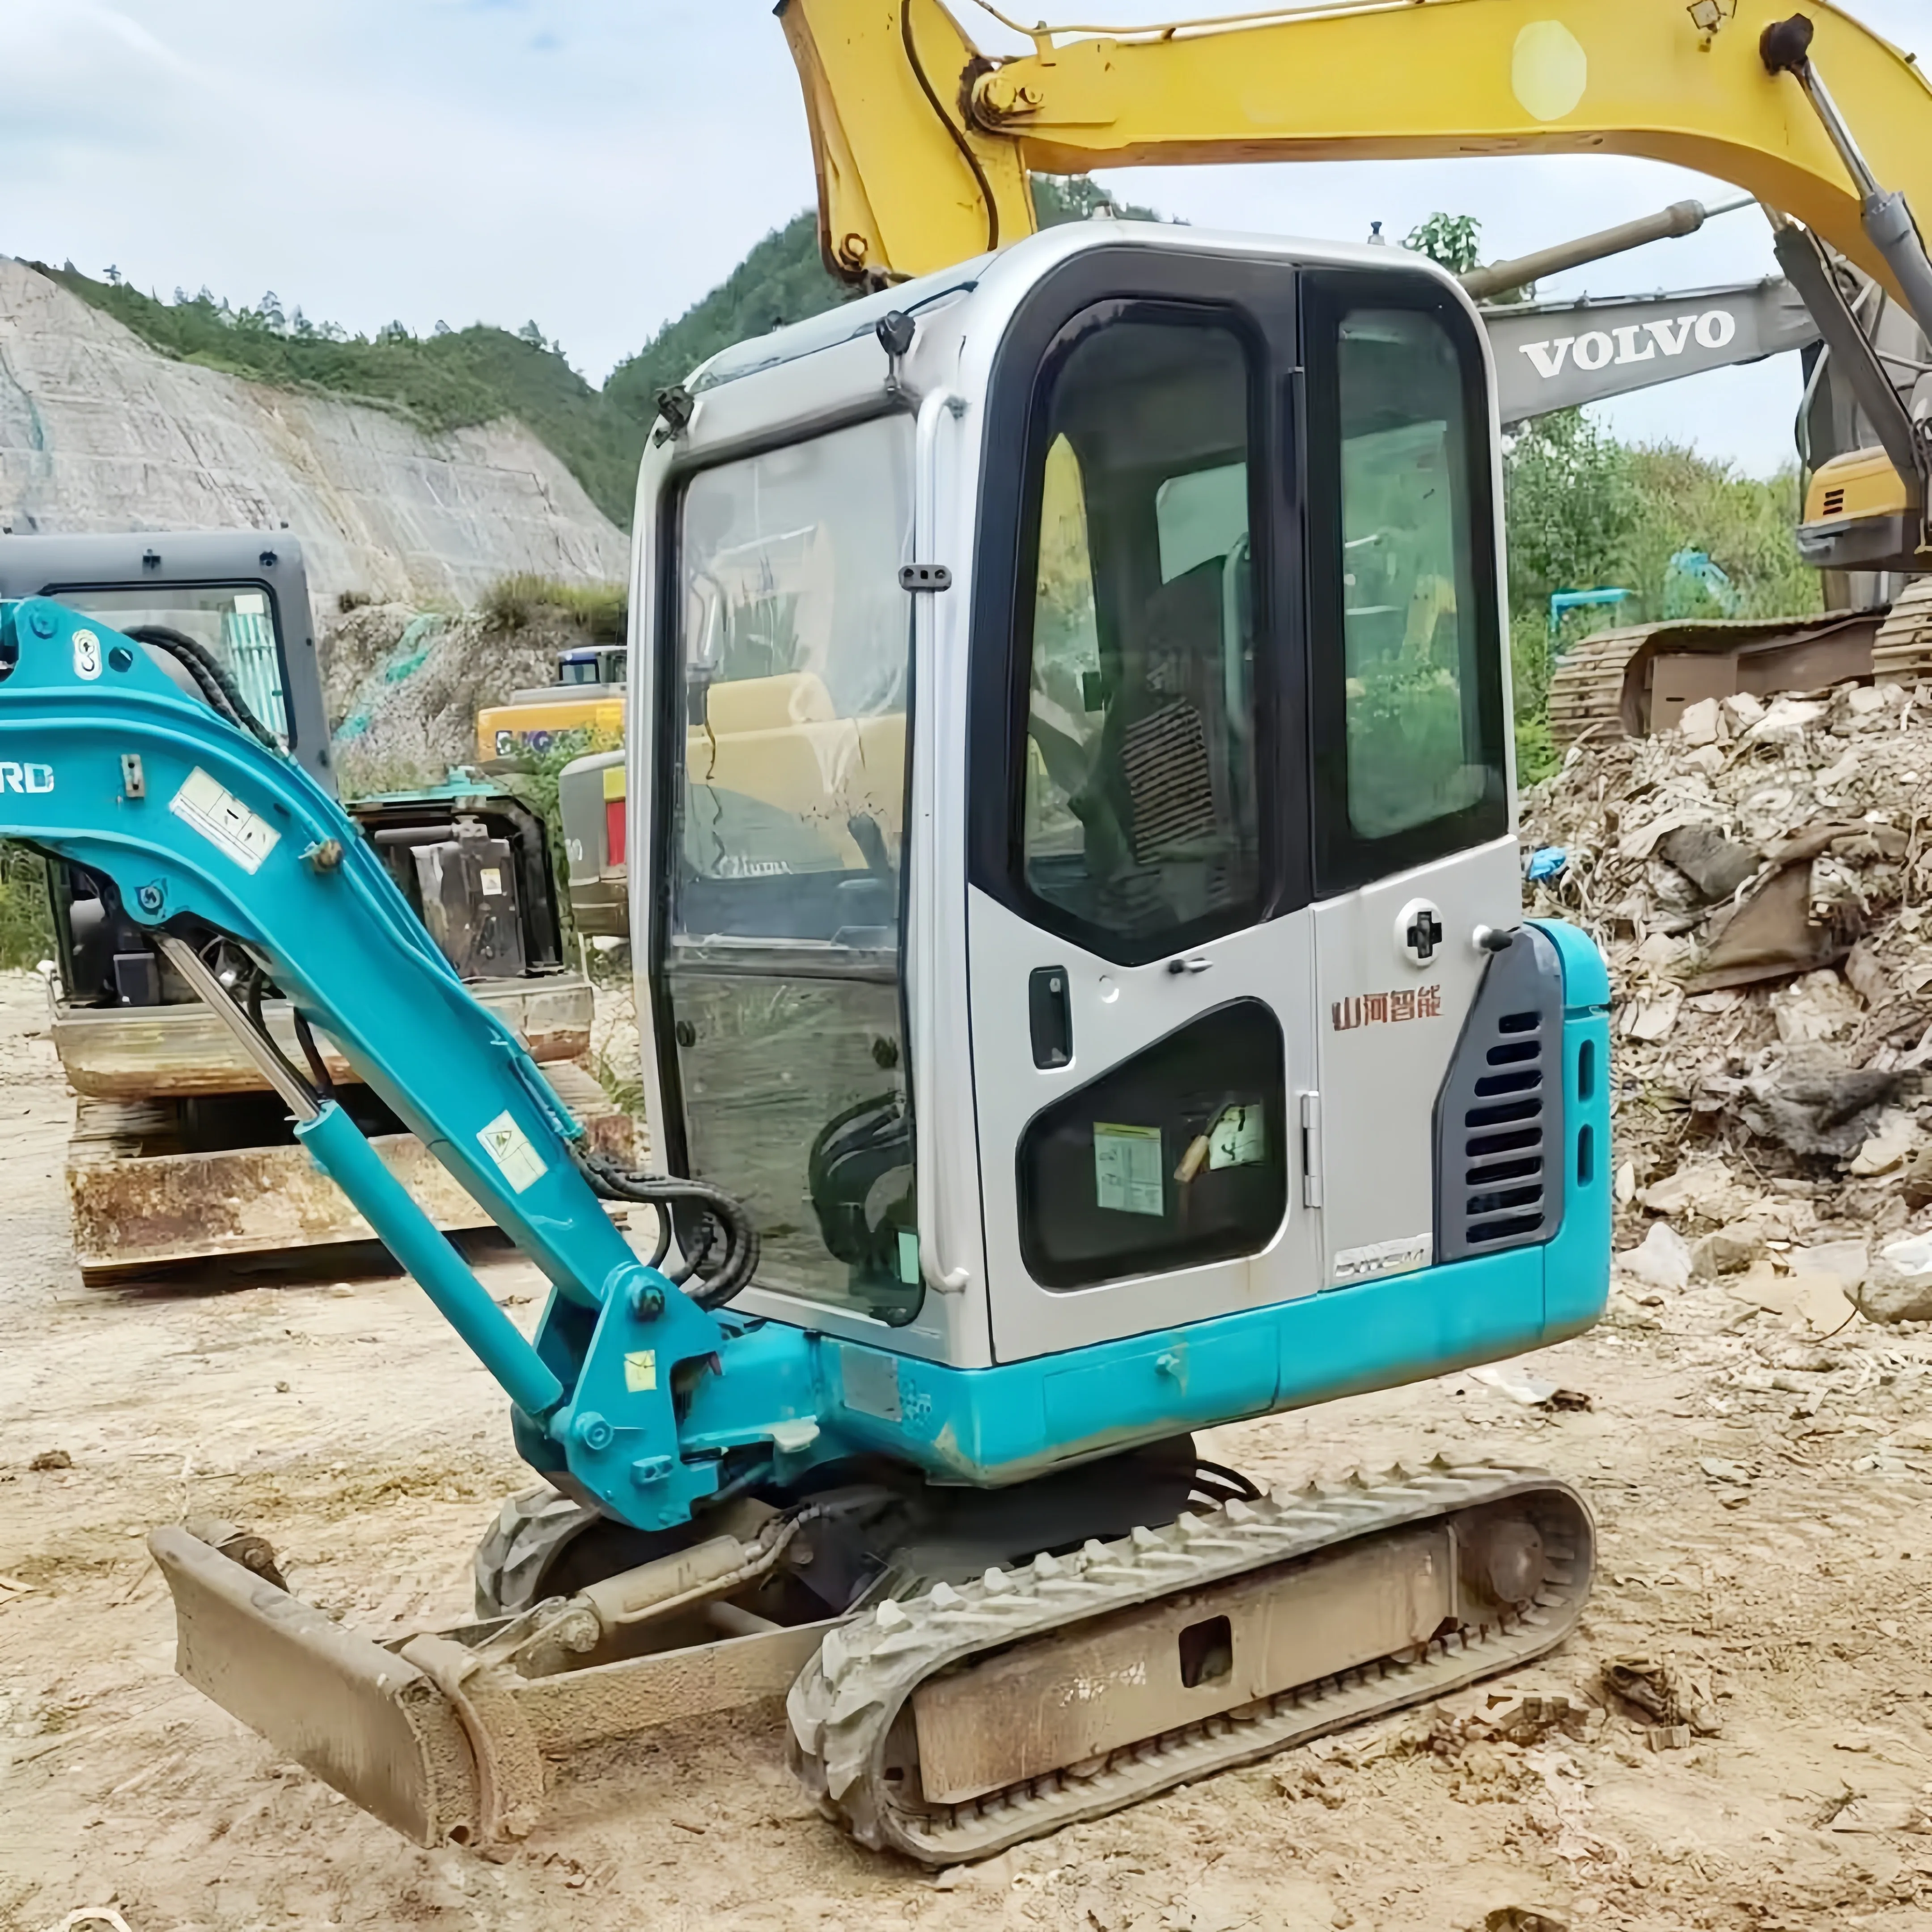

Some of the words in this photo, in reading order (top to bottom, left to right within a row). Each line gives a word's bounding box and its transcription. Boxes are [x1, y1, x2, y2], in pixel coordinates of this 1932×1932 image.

[1519, 310, 1736, 378] VOLVO
[1332, 984, 1444, 1031] 山河智能
